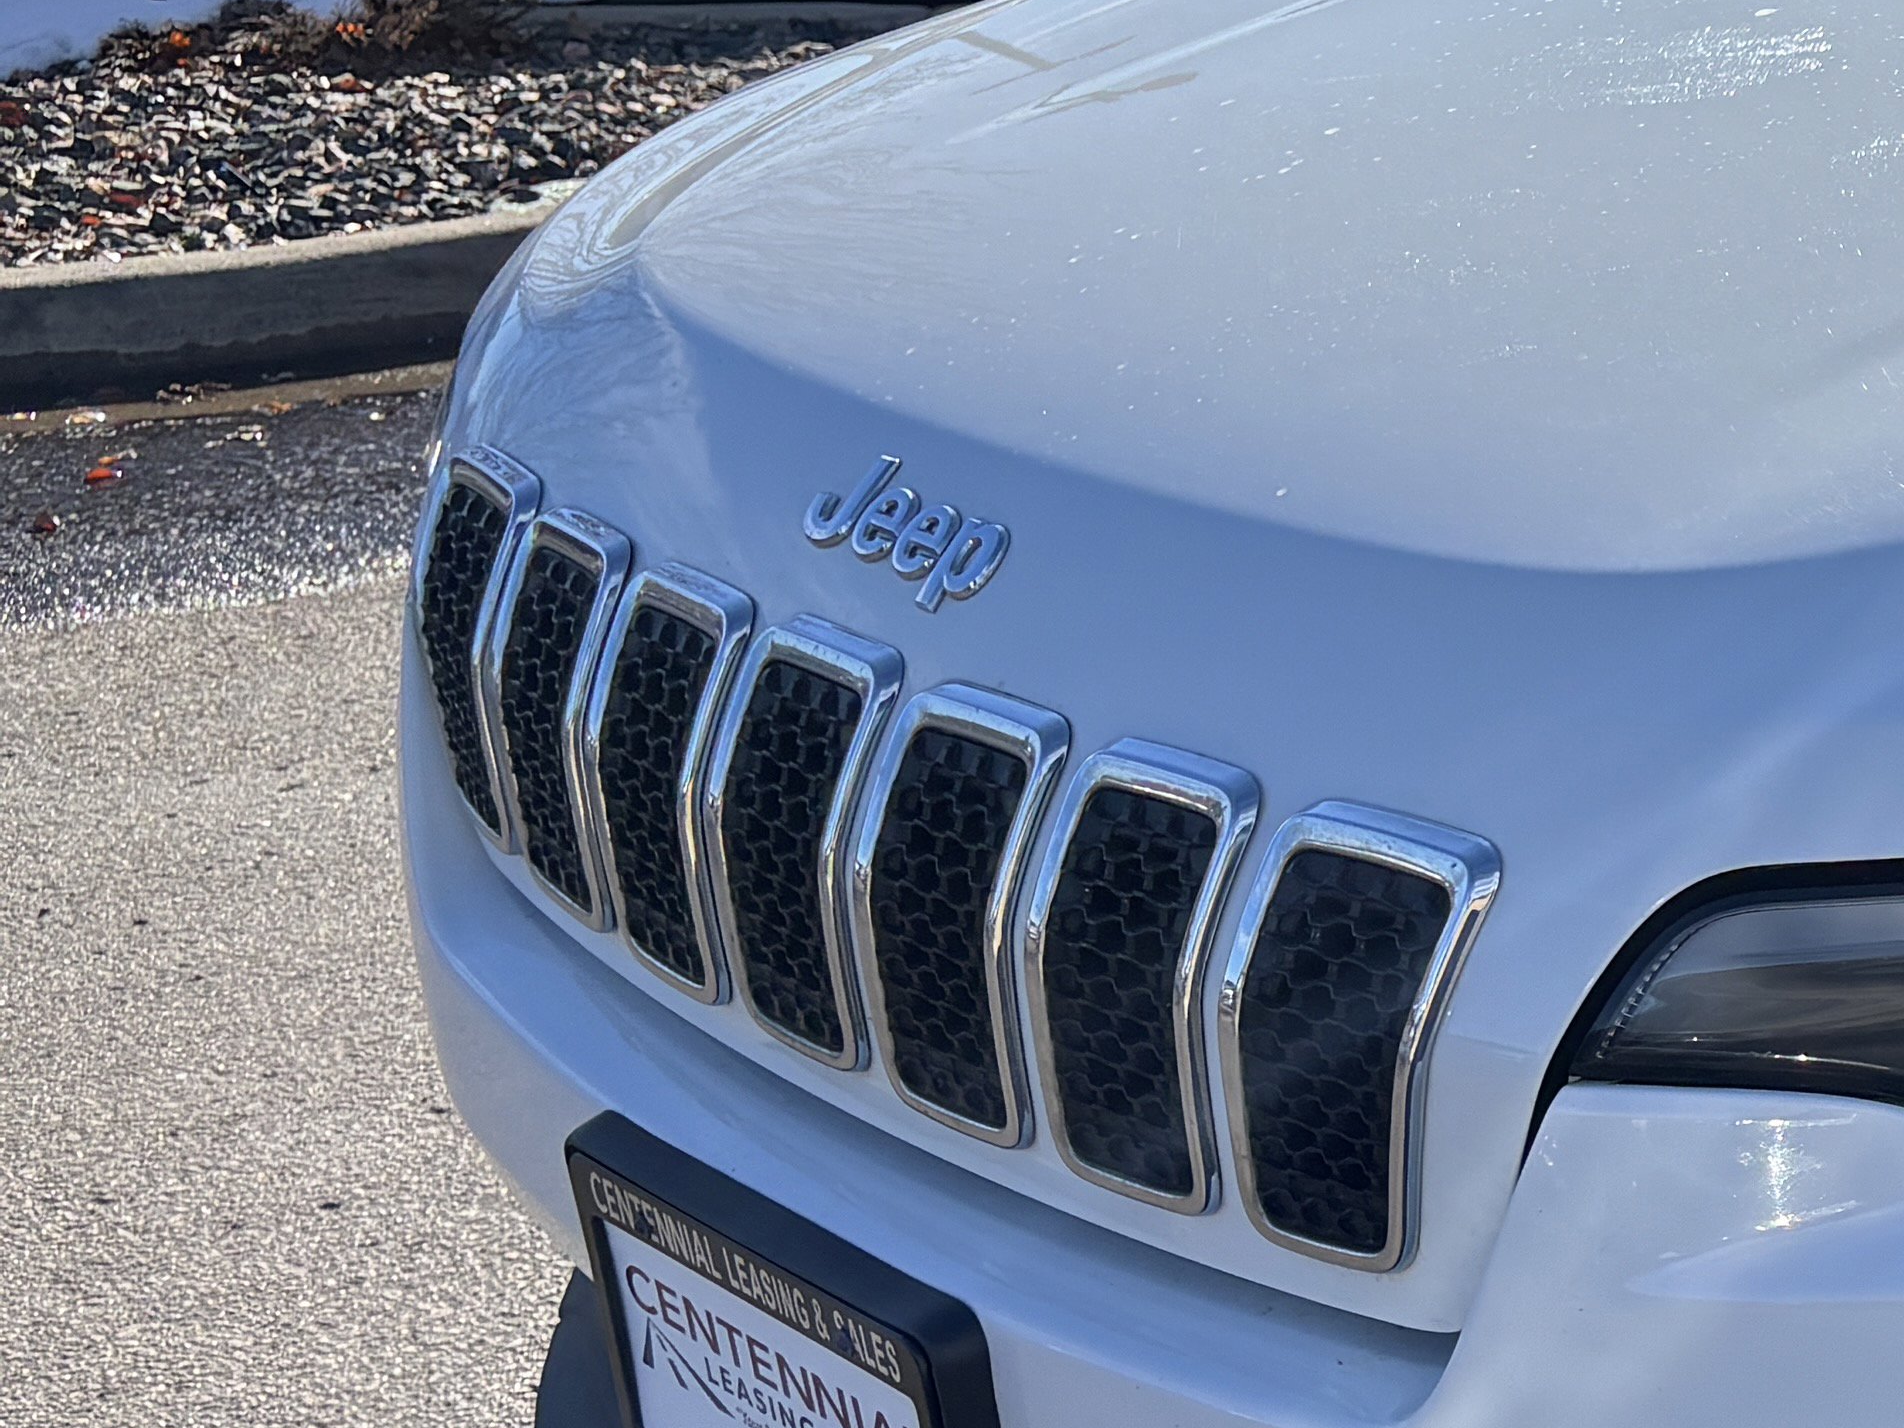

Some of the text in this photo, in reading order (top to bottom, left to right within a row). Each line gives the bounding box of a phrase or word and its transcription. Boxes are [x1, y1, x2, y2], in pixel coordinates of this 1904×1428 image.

[802, 454, 1011, 614] Jeep
[722, 1246, 811, 1330] LEASING
[811, 1297, 831, 1342] &
